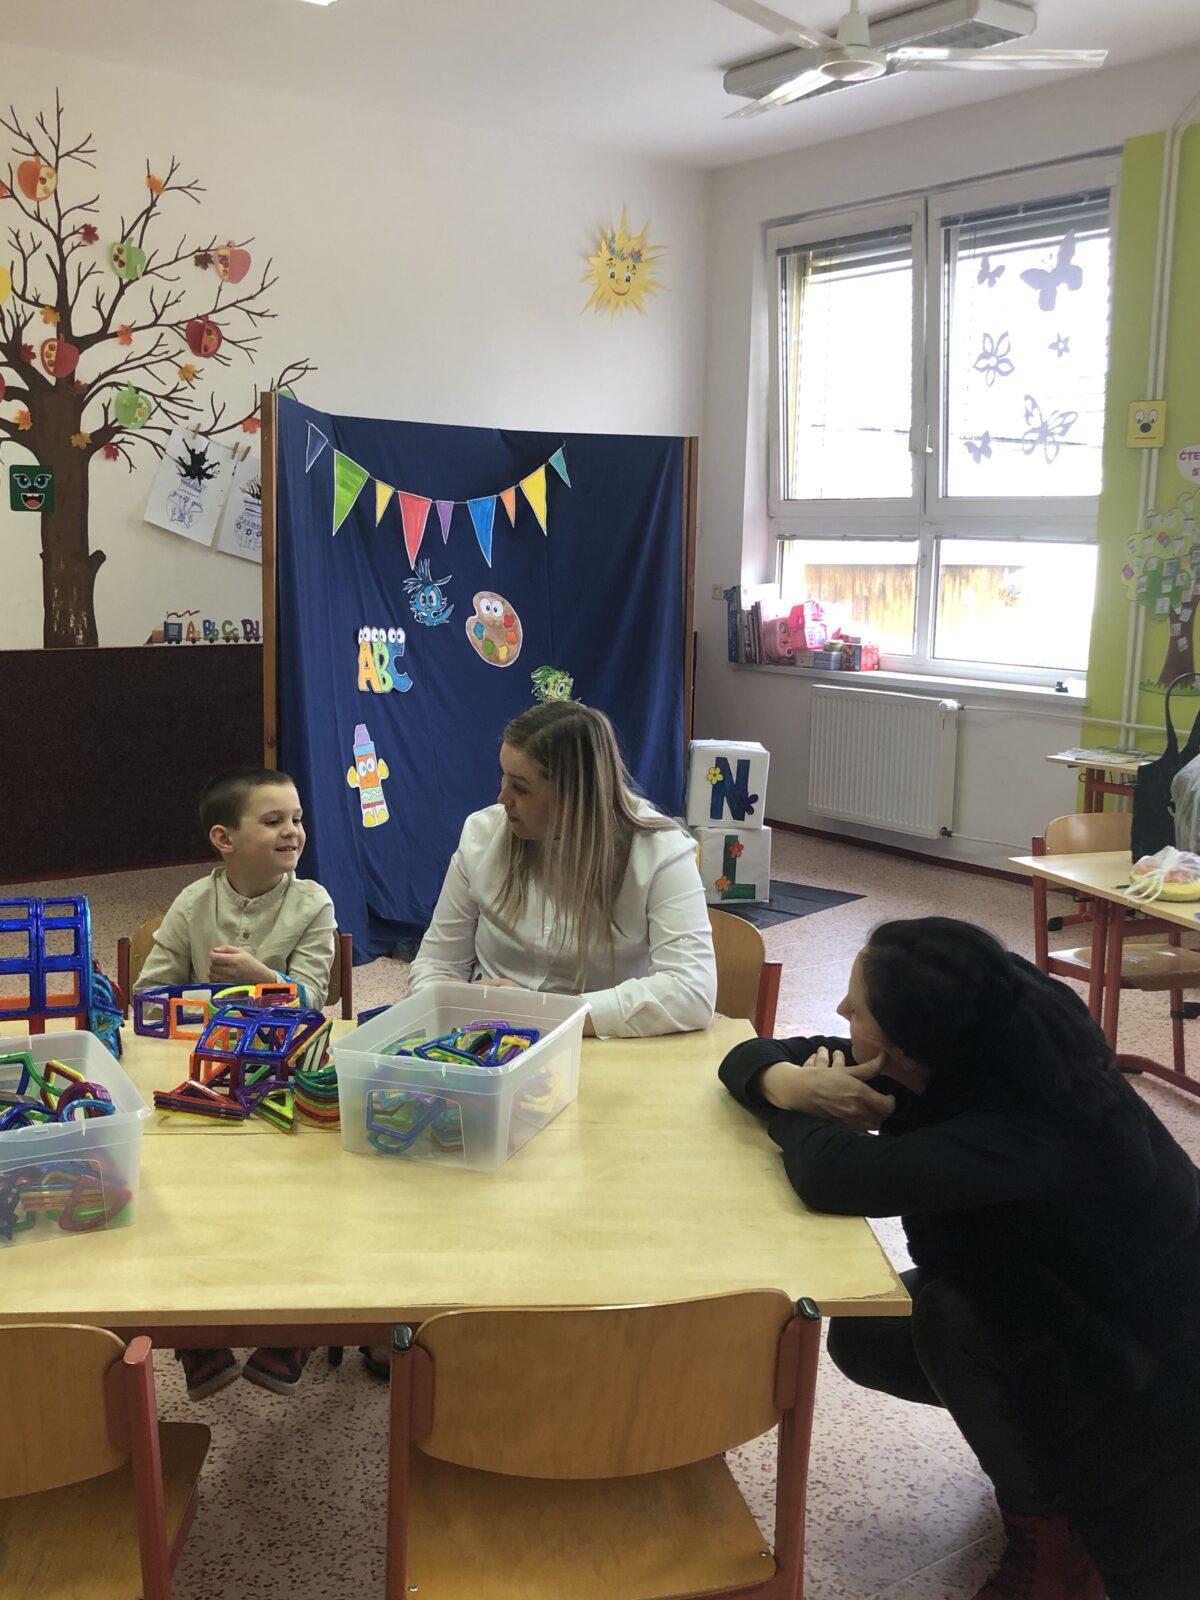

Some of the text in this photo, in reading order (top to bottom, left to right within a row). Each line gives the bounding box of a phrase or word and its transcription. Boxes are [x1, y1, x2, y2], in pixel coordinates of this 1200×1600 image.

[357, 637, 413, 693] ABC
[709, 756, 751, 821] N
[720, 834, 756, 900] L
